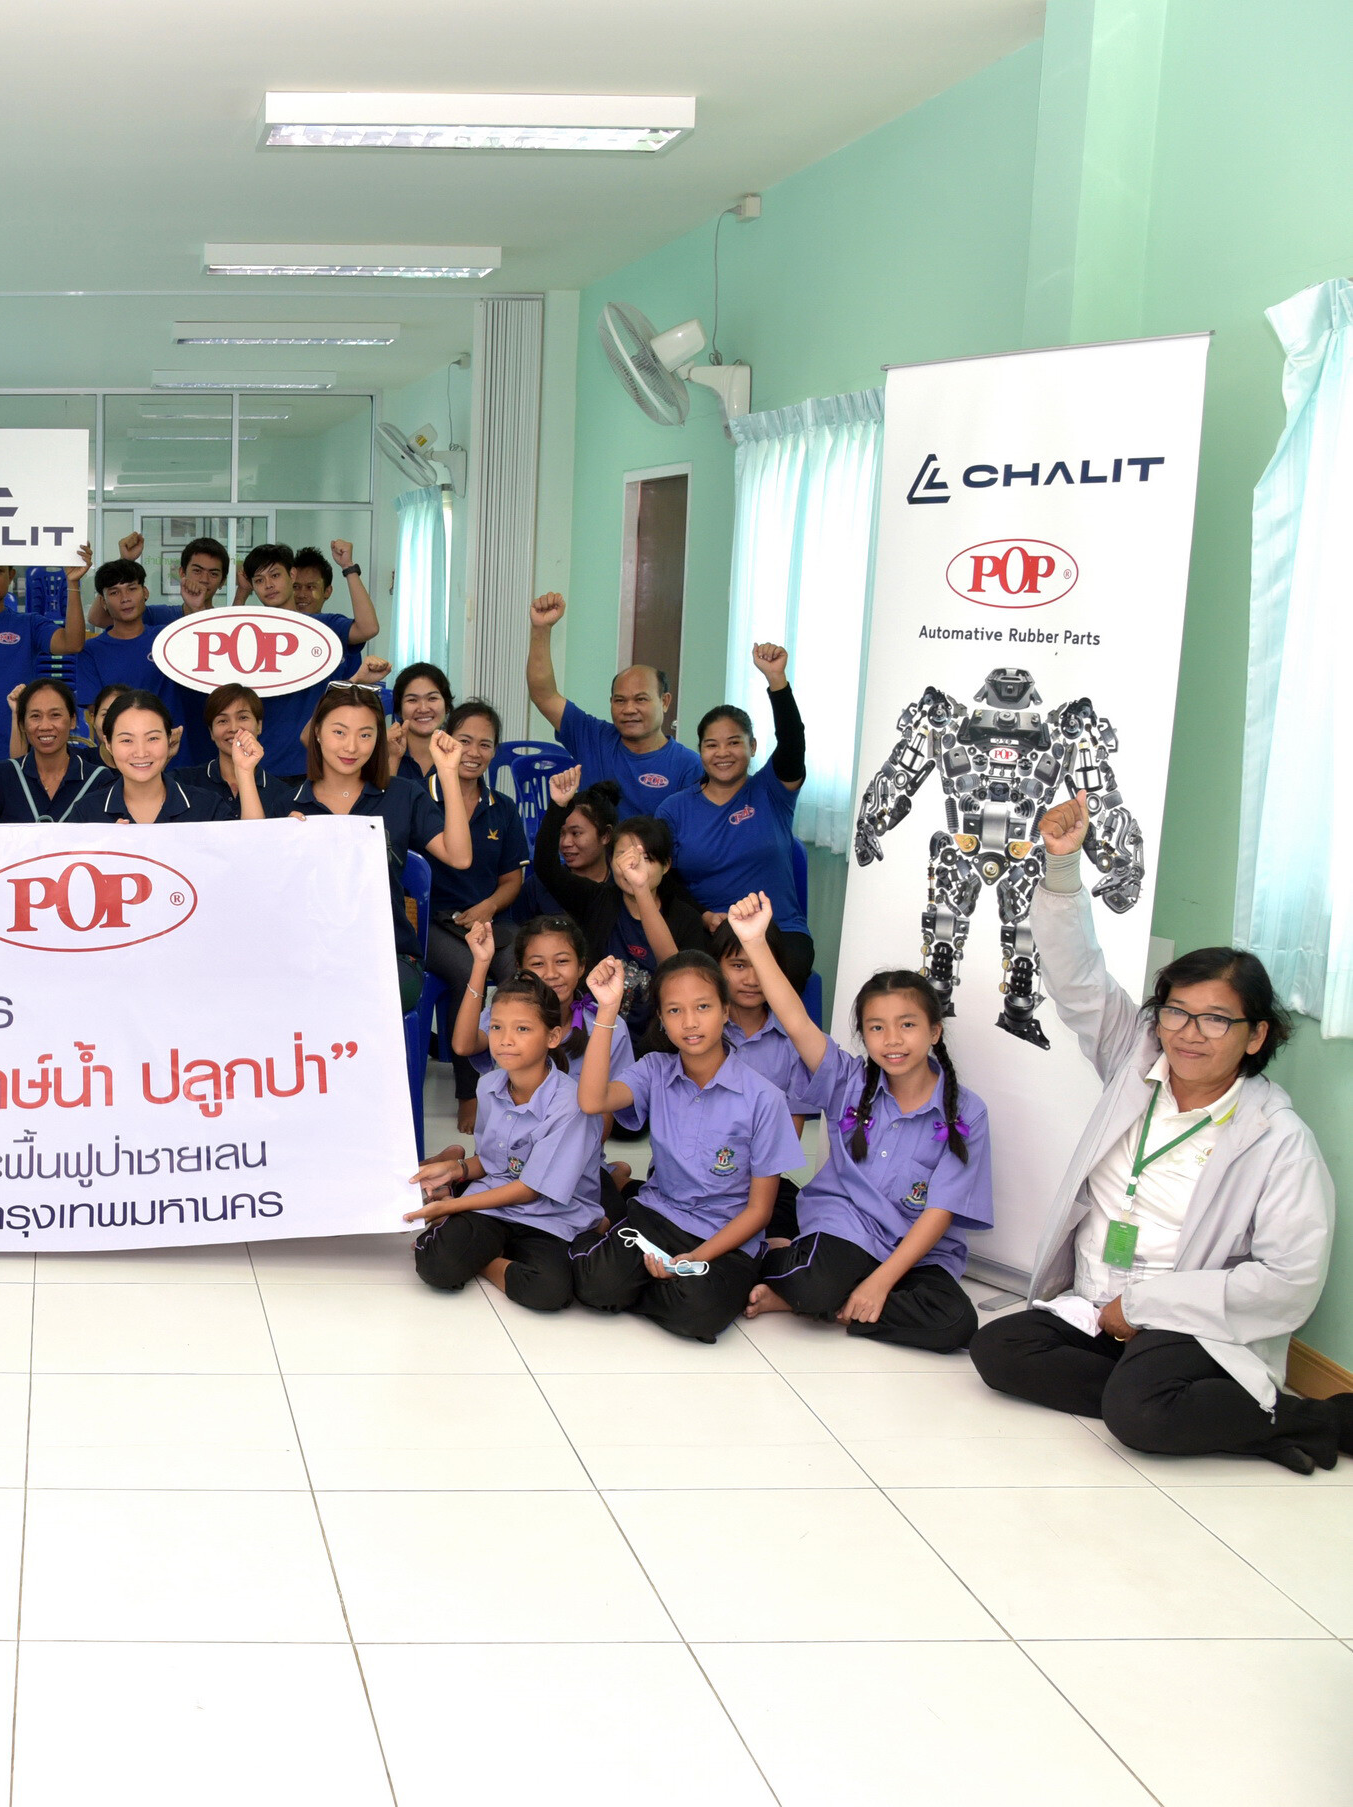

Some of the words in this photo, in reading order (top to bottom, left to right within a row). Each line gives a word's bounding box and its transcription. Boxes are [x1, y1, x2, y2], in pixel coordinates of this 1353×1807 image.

[962, 457, 1165, 489] CHALIT
[967, 546, 1055, 594] POP
[192, 622, 299, 674] POP
[918, 625, 1003, 642] Automative
[1008, 628, 1060, 644] Rubber
[1063, 630, 1101, 646] Parts
[7, 862, 153, 932] POP
